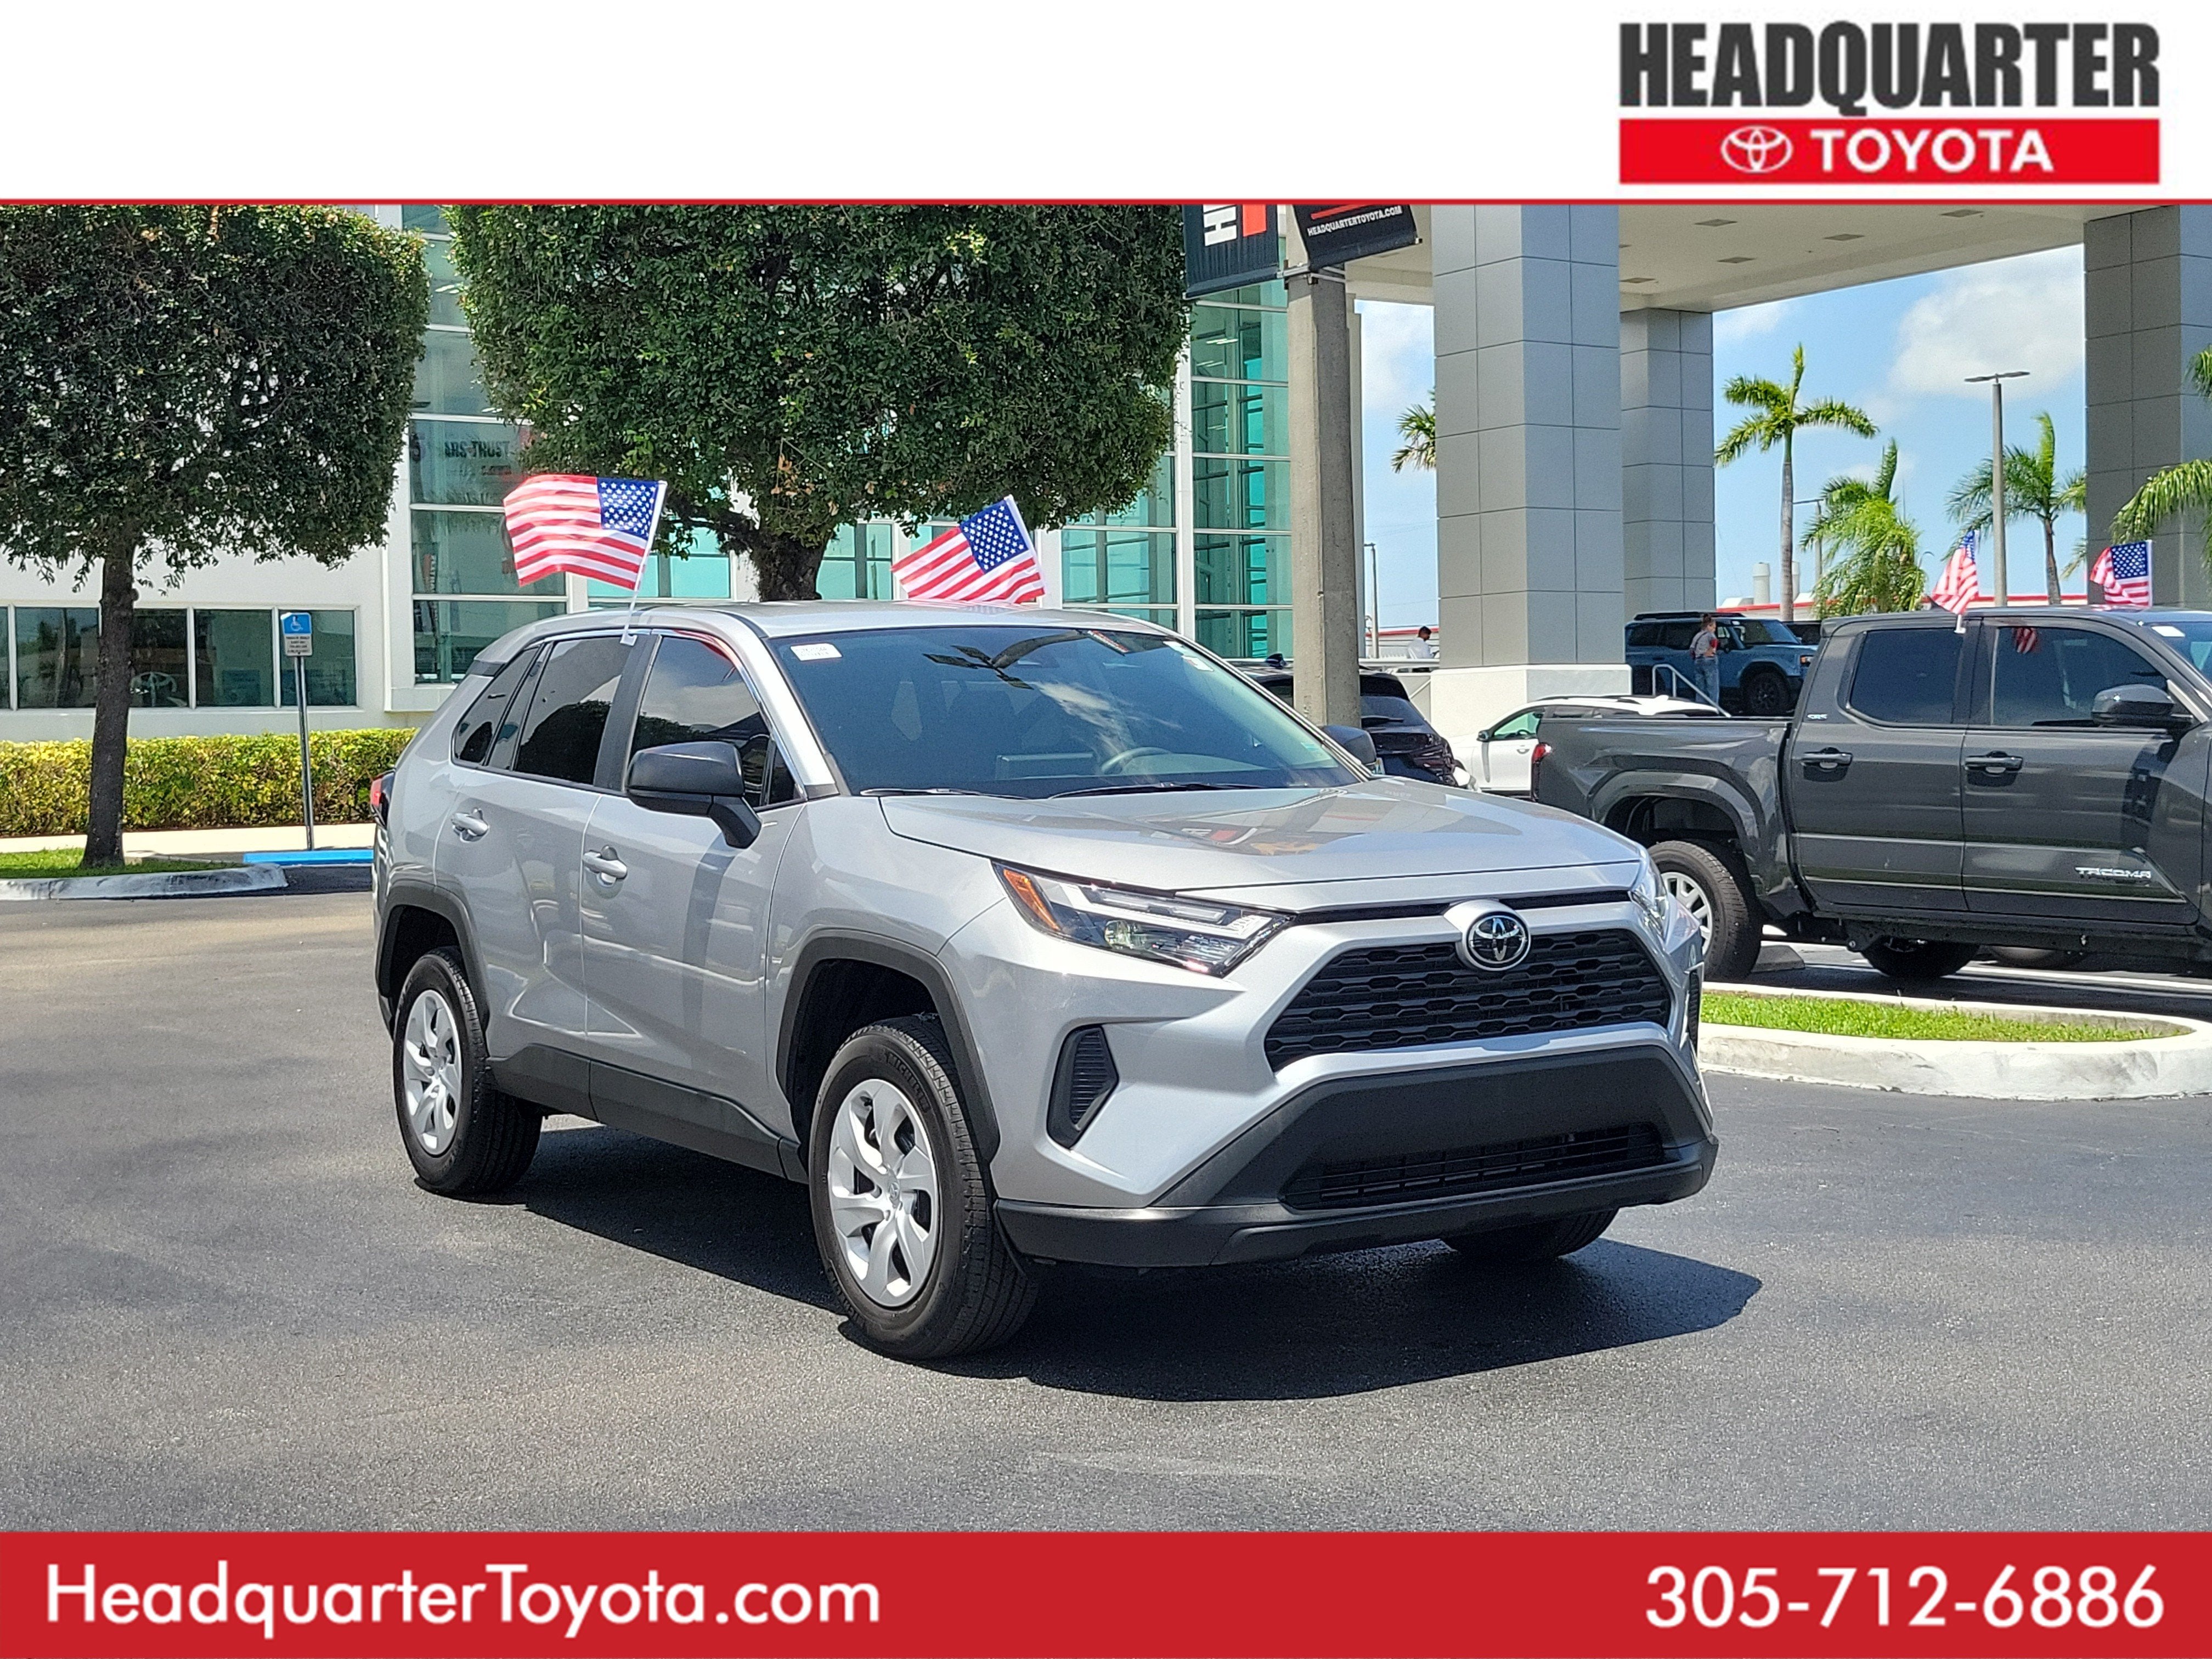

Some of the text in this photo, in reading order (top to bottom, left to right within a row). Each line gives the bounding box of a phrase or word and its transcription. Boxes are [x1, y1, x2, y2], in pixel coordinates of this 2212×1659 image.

[1307, 205, 1403, 236] HEADQUARTERTOYOTA.COM
[471, 441, 510, 458] TRUST
[2075, 867, 2151, 879] TACOMA
